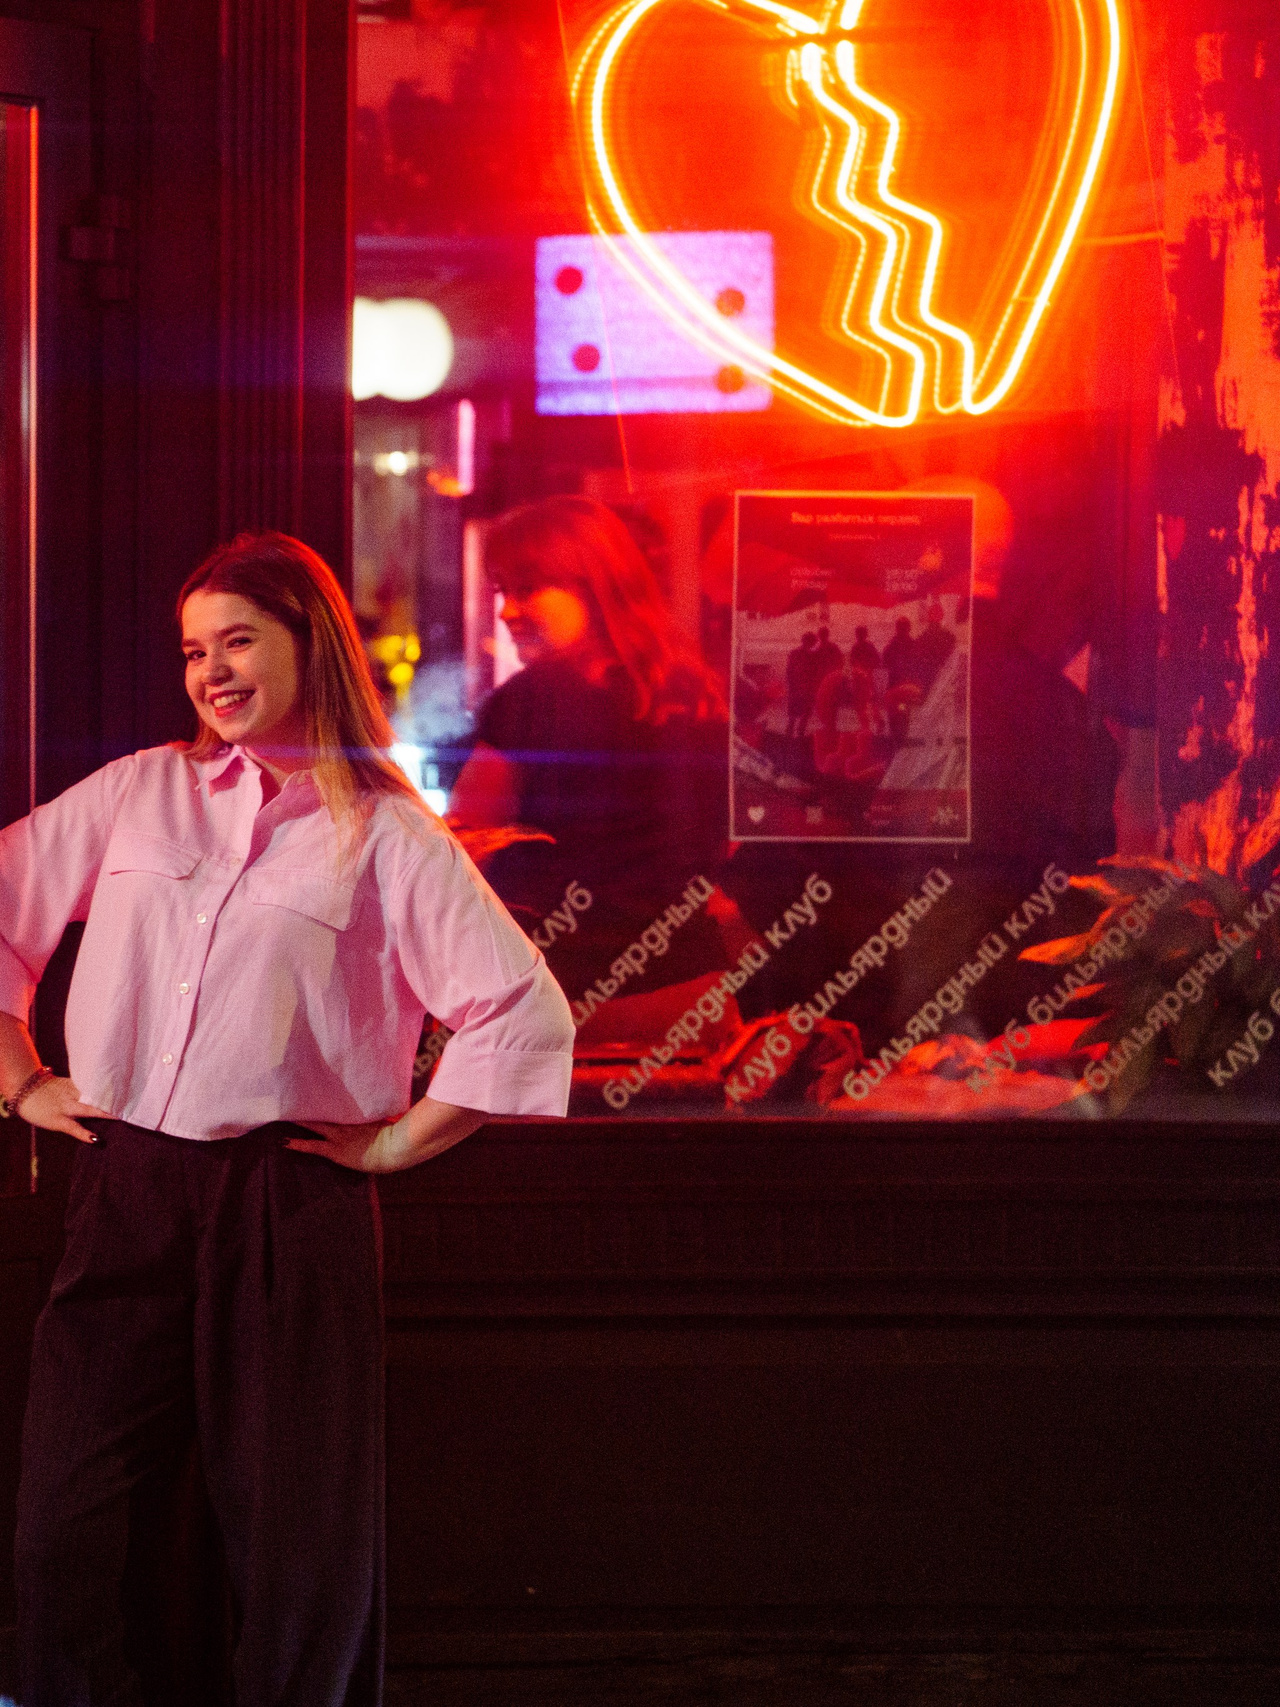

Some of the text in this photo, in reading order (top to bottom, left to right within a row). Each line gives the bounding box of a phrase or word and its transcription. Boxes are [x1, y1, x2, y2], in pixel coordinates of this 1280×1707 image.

[571, 875, 715, 1028] ильярдный
[602, 873, 833, 1109] бильярдный клуб
[723, 867, 954, 1103] клуб бильярдный
[842, 862, 1071, 1101] бильярдный клуб
[1083, 920, 1250, 1091] бильярдный
[965, 1018, 1032, 1095] клуб
[1206, 1011, 1274, 1088] клуб
